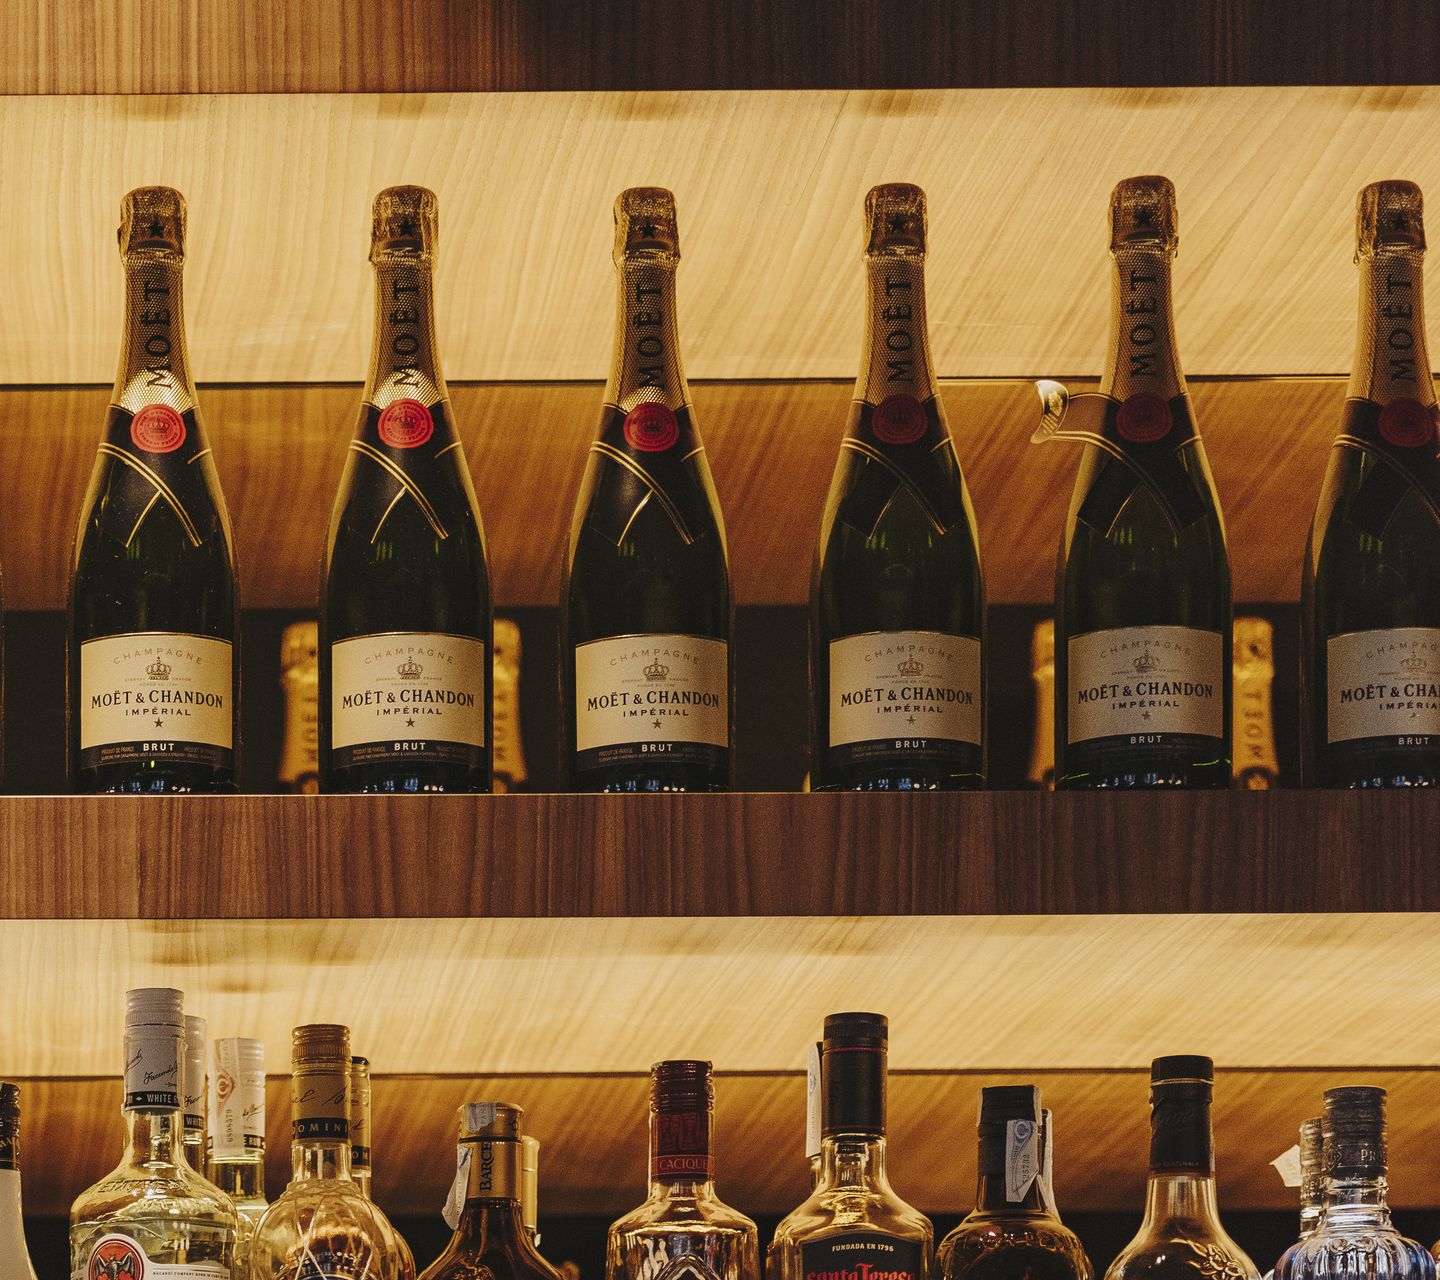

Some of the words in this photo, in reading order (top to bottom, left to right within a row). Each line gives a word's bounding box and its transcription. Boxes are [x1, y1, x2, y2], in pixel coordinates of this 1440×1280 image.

[587, 691, 628, 711] MOËT
[633, 694, 643, 704] &
[646, 690, 719, 708] CHANDON
[1078, 684, 1119, 703] MOËT
[1123, 687, 1132, 696] &
[1135, 682, 1213, 698] CHANDON
[641, 743, 673, 752] BRUT
[831, 1243, 865, 1252] FUNDADA
[866, 1242, 877, 1251] EN
[877, 1243, 895, 1253] 1796
